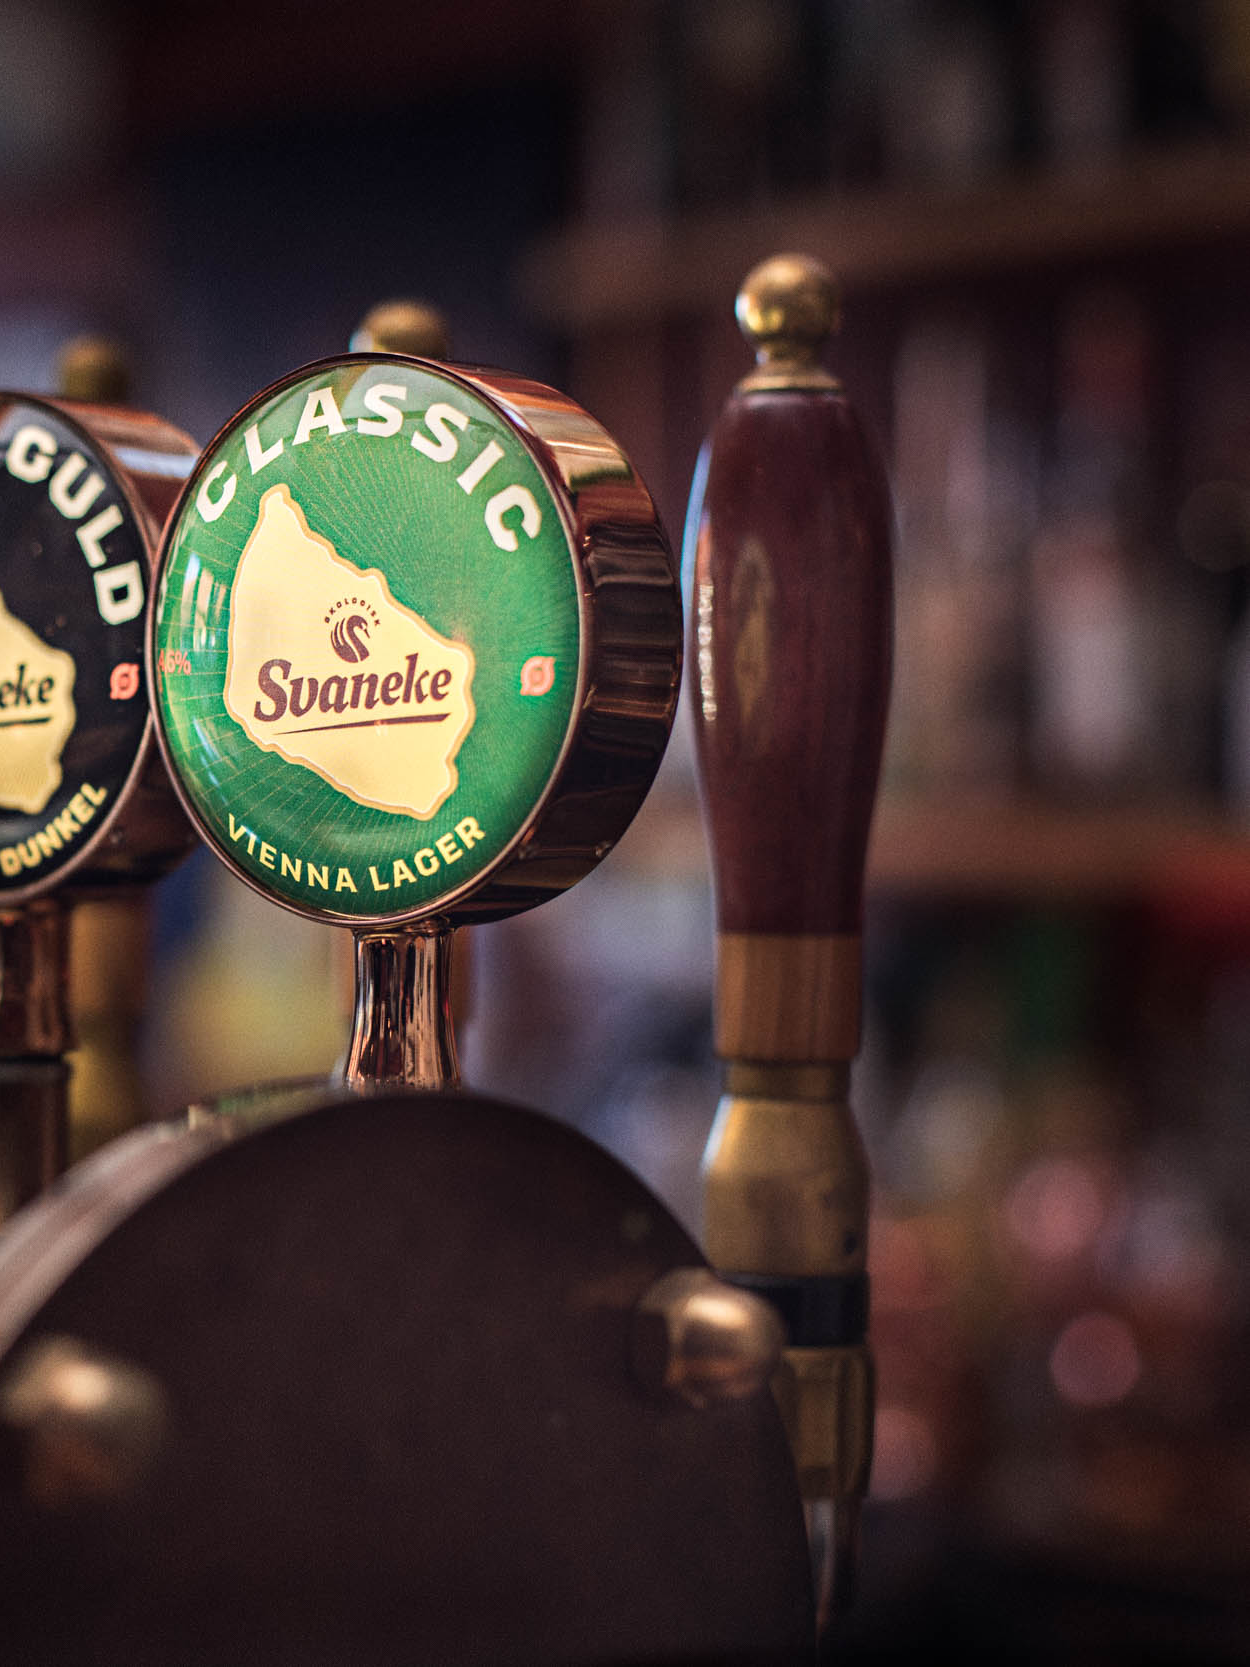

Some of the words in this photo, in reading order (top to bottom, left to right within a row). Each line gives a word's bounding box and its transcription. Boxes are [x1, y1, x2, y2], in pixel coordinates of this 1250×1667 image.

[5, 425, 144, 625] GULD
[195, 384, 542, 552] CLASSIC
[254, 652, 452, 722] Svaneke
[228, 813, 358, 894] VIENNA
[368, 816, 486, 892] LAGER
